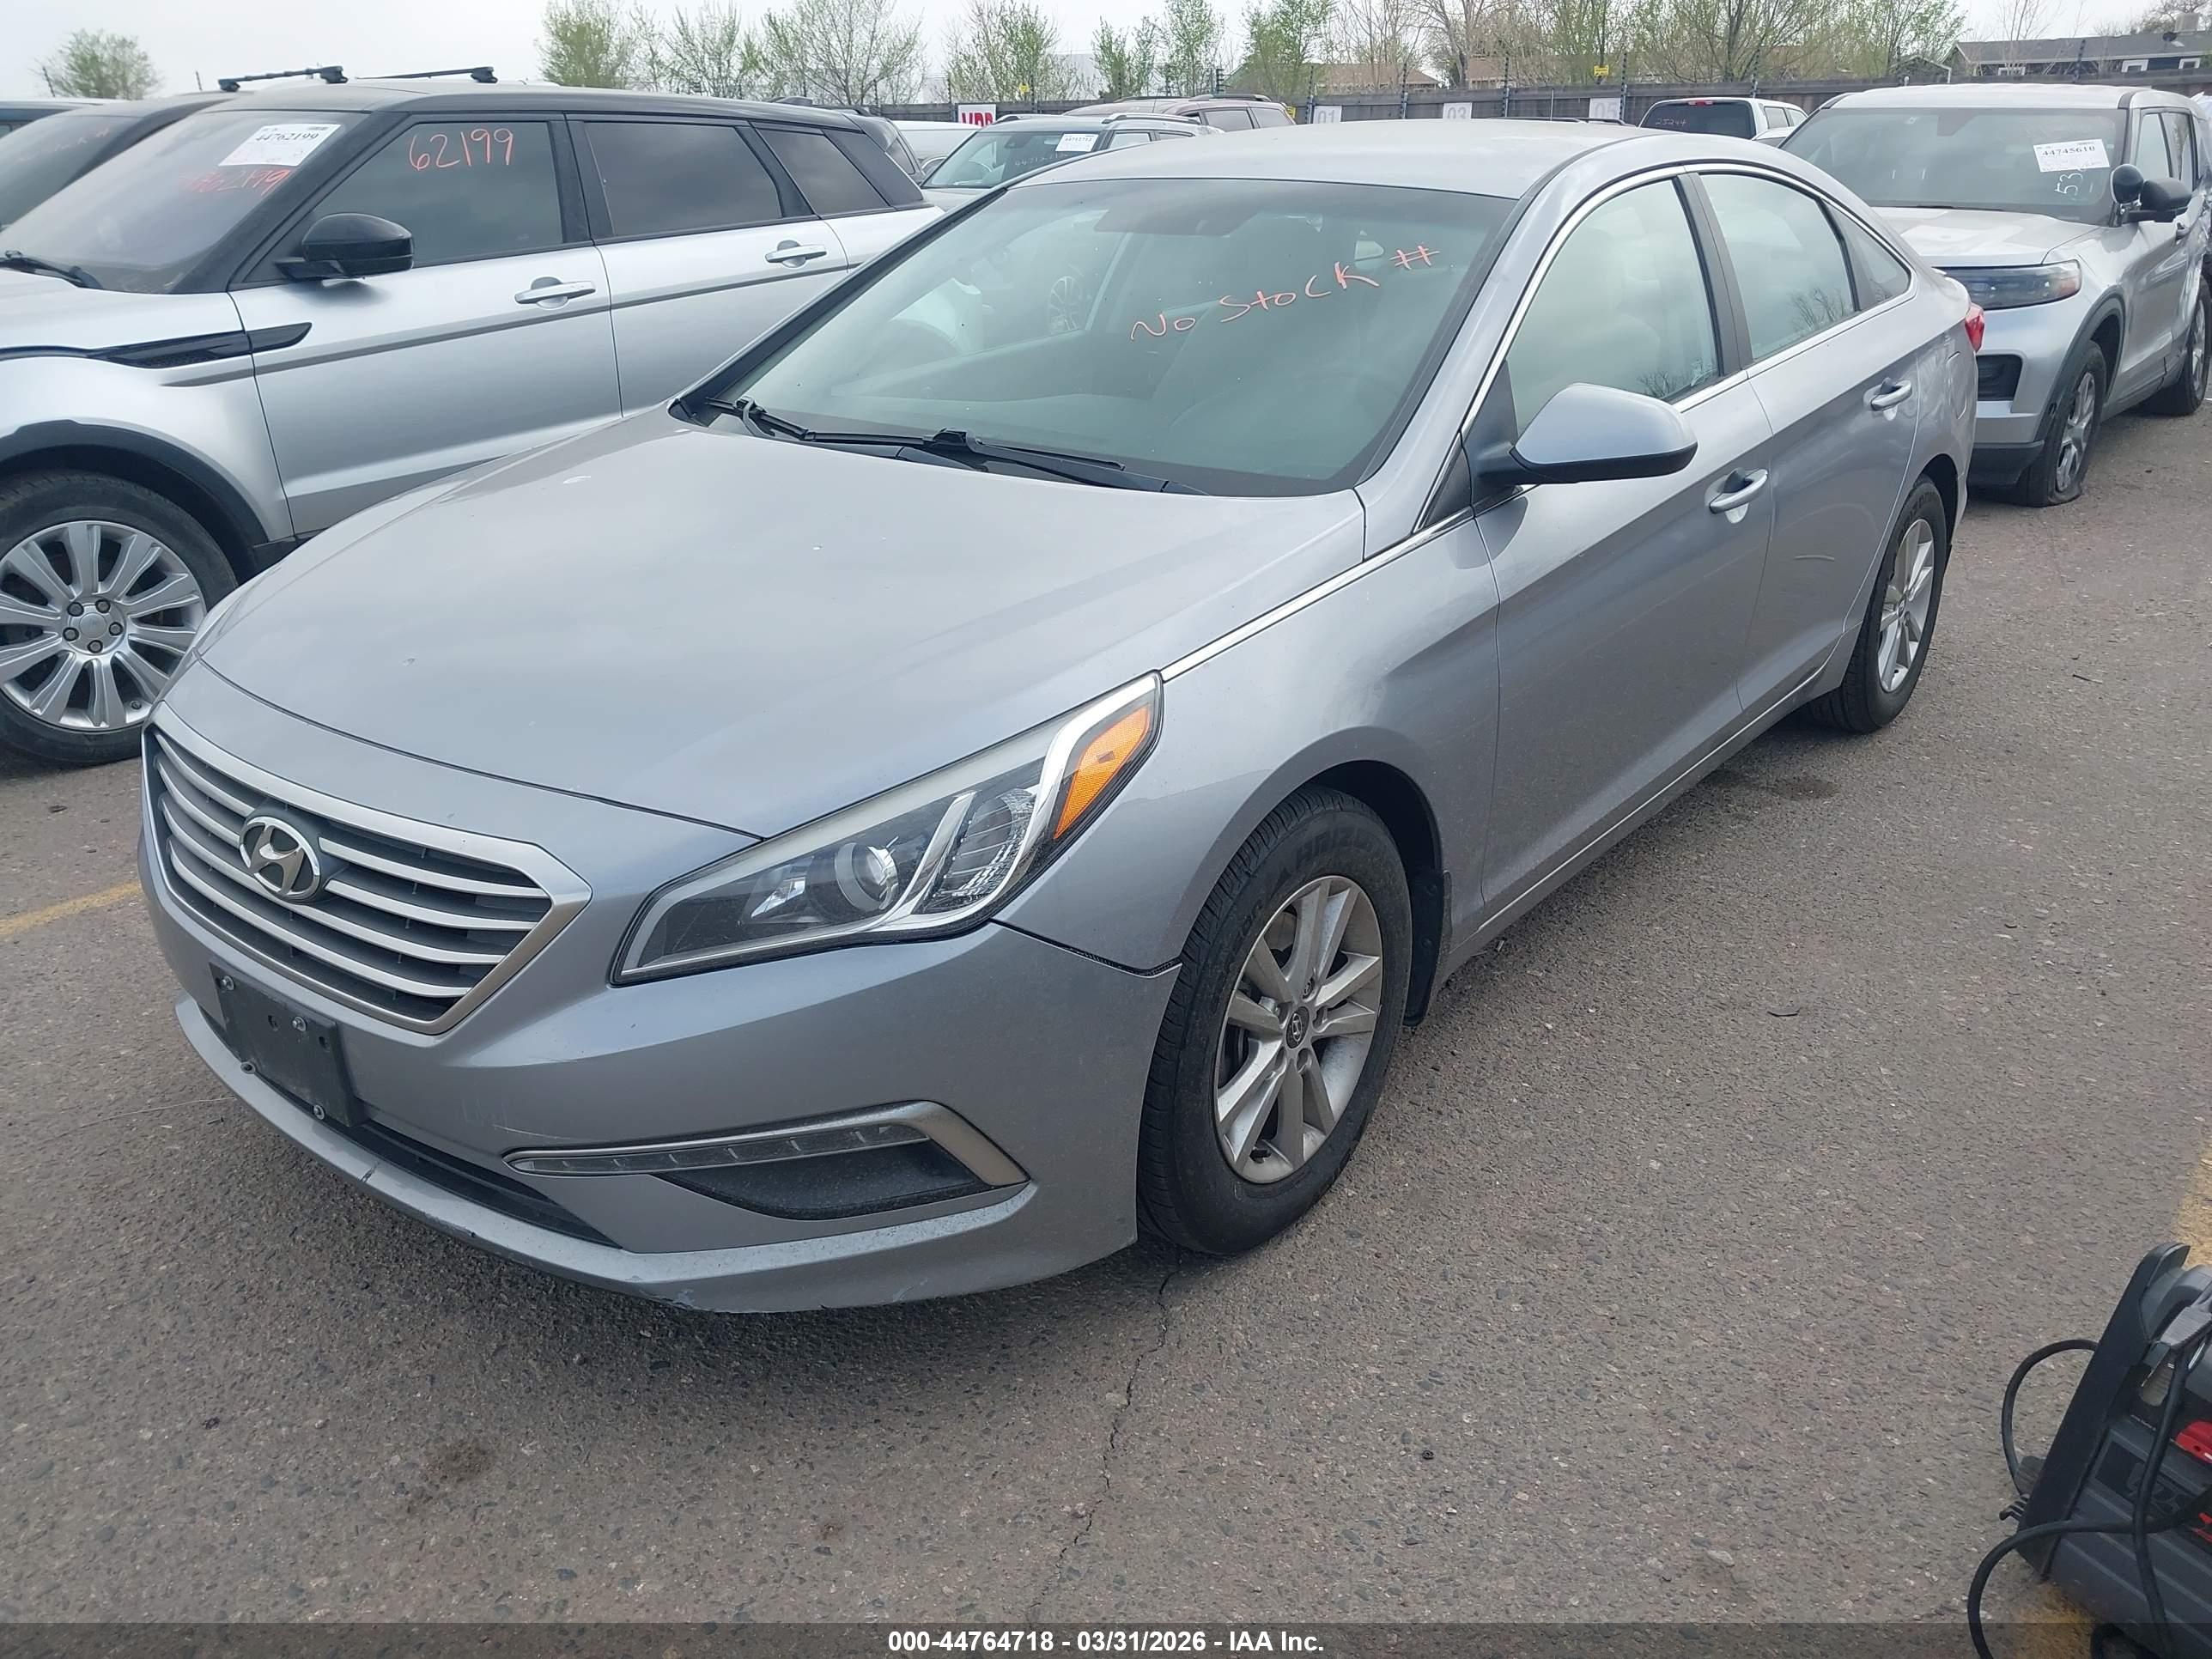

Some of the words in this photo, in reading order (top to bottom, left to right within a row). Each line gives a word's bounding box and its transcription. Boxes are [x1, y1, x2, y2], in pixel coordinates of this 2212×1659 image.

[409, 128, 514, 171] 62199
[1129, 314, 1196, 340] No
[1389, 244, 1441, 270] #
